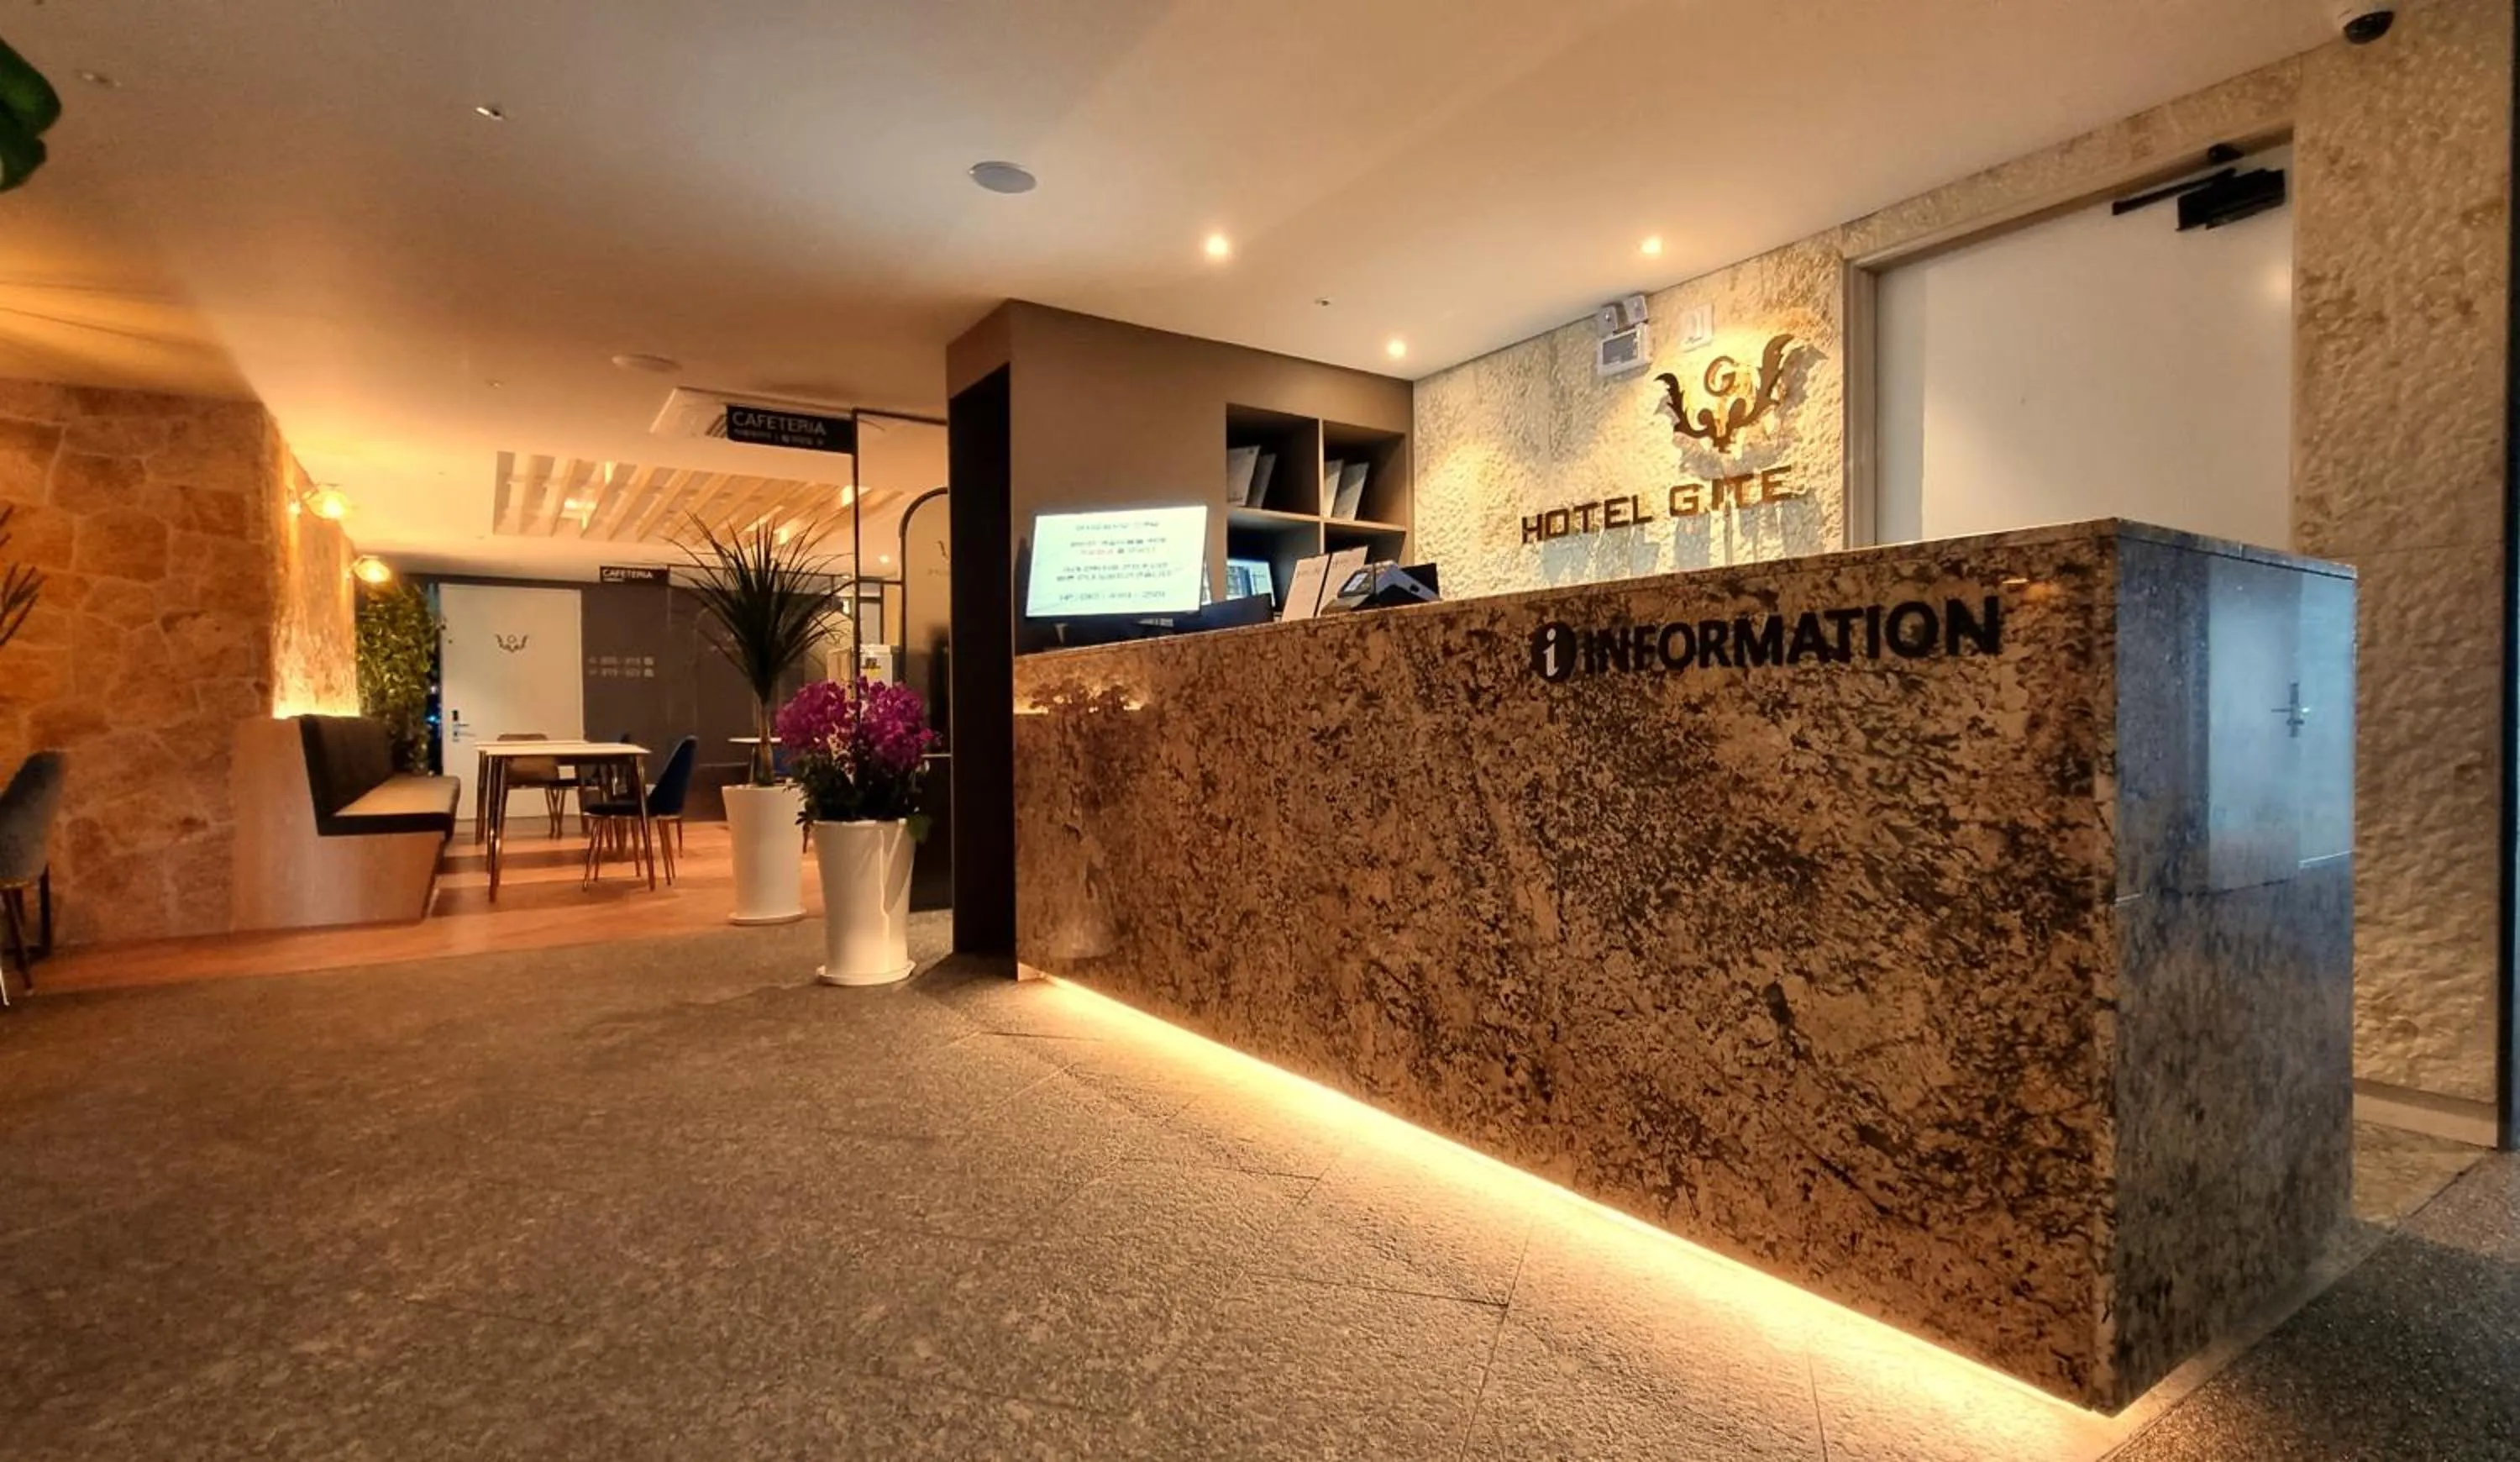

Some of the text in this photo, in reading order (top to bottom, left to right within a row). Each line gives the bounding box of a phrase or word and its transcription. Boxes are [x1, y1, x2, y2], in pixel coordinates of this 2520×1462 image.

[732, 410, 827, 436] CAFETERIA
[1521, 465, 1793, 544] HOTEL GITE
[601, 568, 654, 579] CAFETERIA
[1583, 595, 2001, 673] INFORMATION
